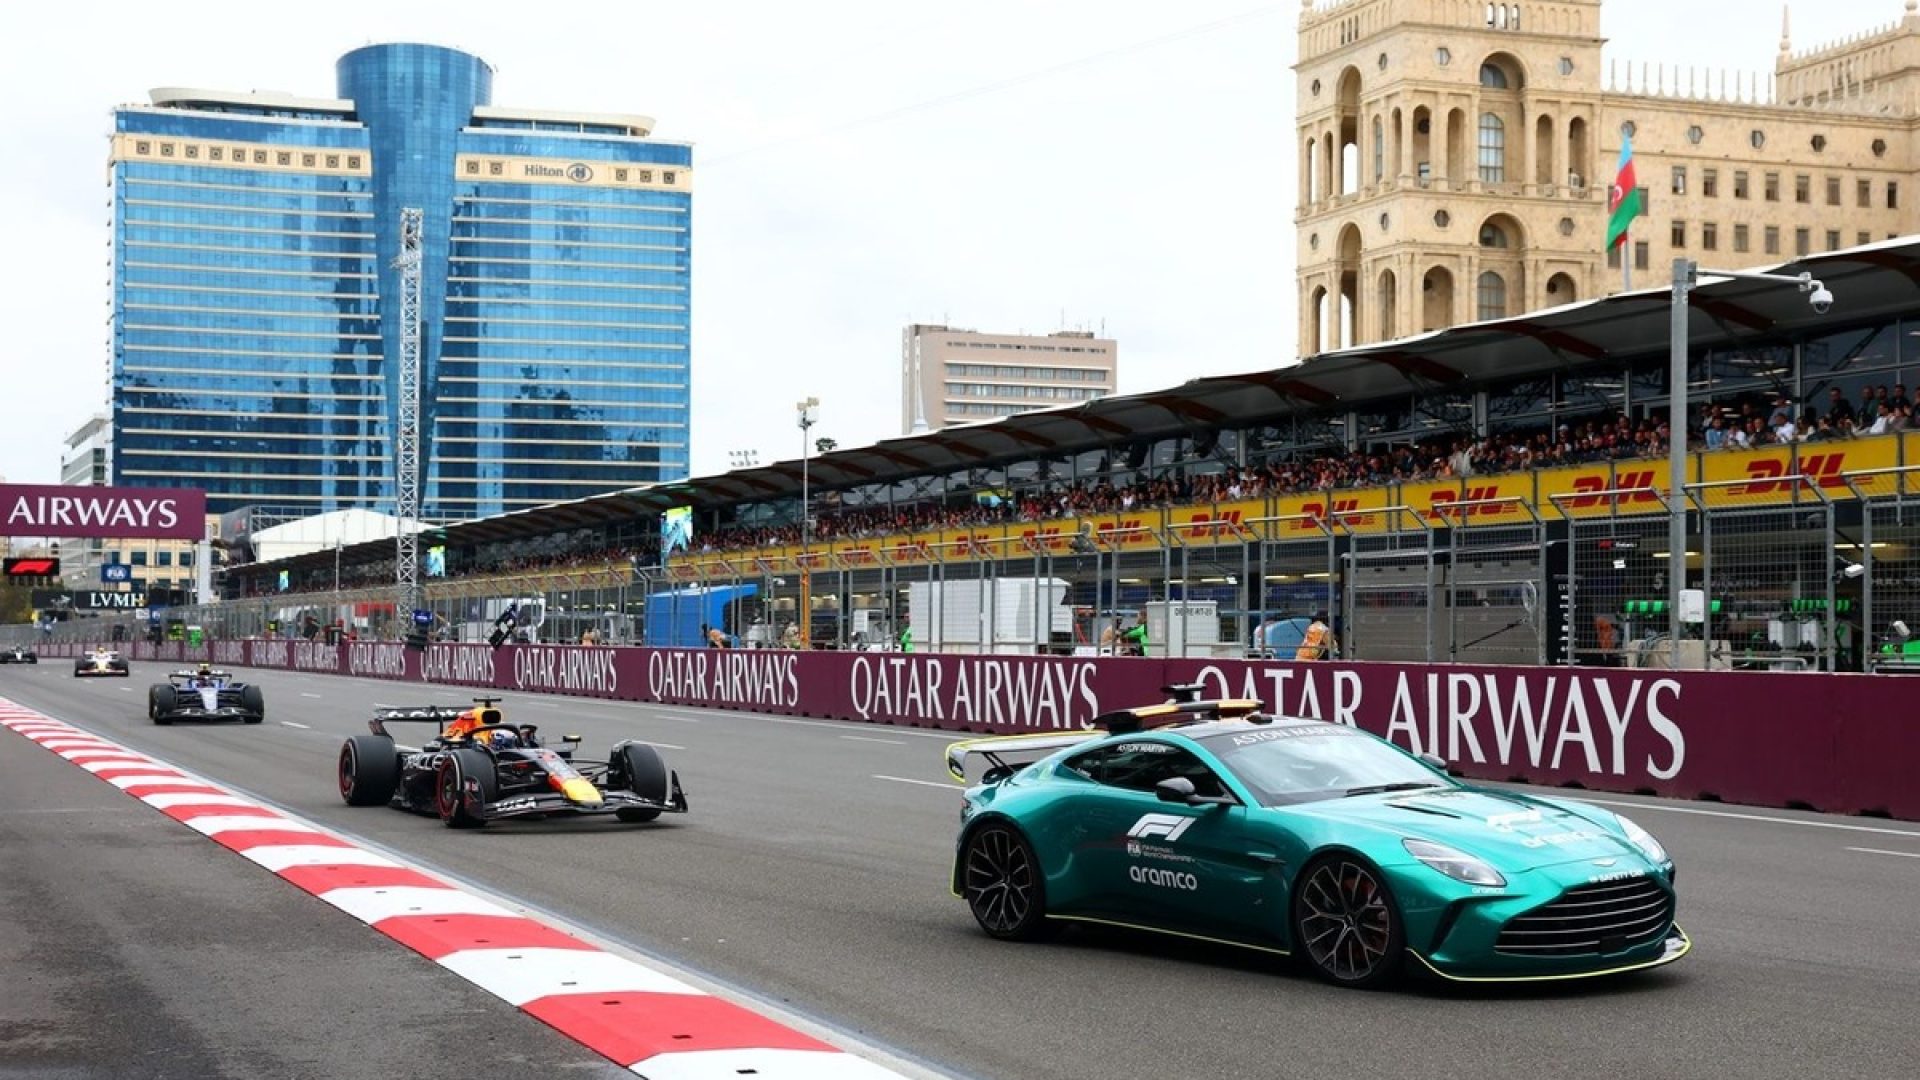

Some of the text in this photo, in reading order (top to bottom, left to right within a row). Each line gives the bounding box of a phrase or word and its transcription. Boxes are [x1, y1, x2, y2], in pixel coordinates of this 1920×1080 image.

[525, 165, 564, 177] Hilton
[1572, 471, 1658, 508] DHL
[1745, 453, 1846, 494] DHL
[8, 495, 178, 528] AIRWAYS
[1301, 500, 1361, 529] DHL
[1429, 486, 1503, 519] DHL
[1191, 510, 1243, 537] DHL
[90, 593, 144, 607] LVMH
[420, 645, 495, 683] QATAR AIRWAYS
[514, 648, 617, 692] QATAR AIRWAYS
[649, 651, 798, 707] QATAR AIRWAYS
[851, 656, 1099, 731] QATAR AIRWAYS
[1233, 726, 1354, 746] ASTON MARTIN
[1387, 671, 1685, 780] AIRWAYS
[1117, 744, 1167, 753] ASTON MARTIN
[1126, 812, 1197, 842] F1
[1129, 865, 1198, 891] aramco
